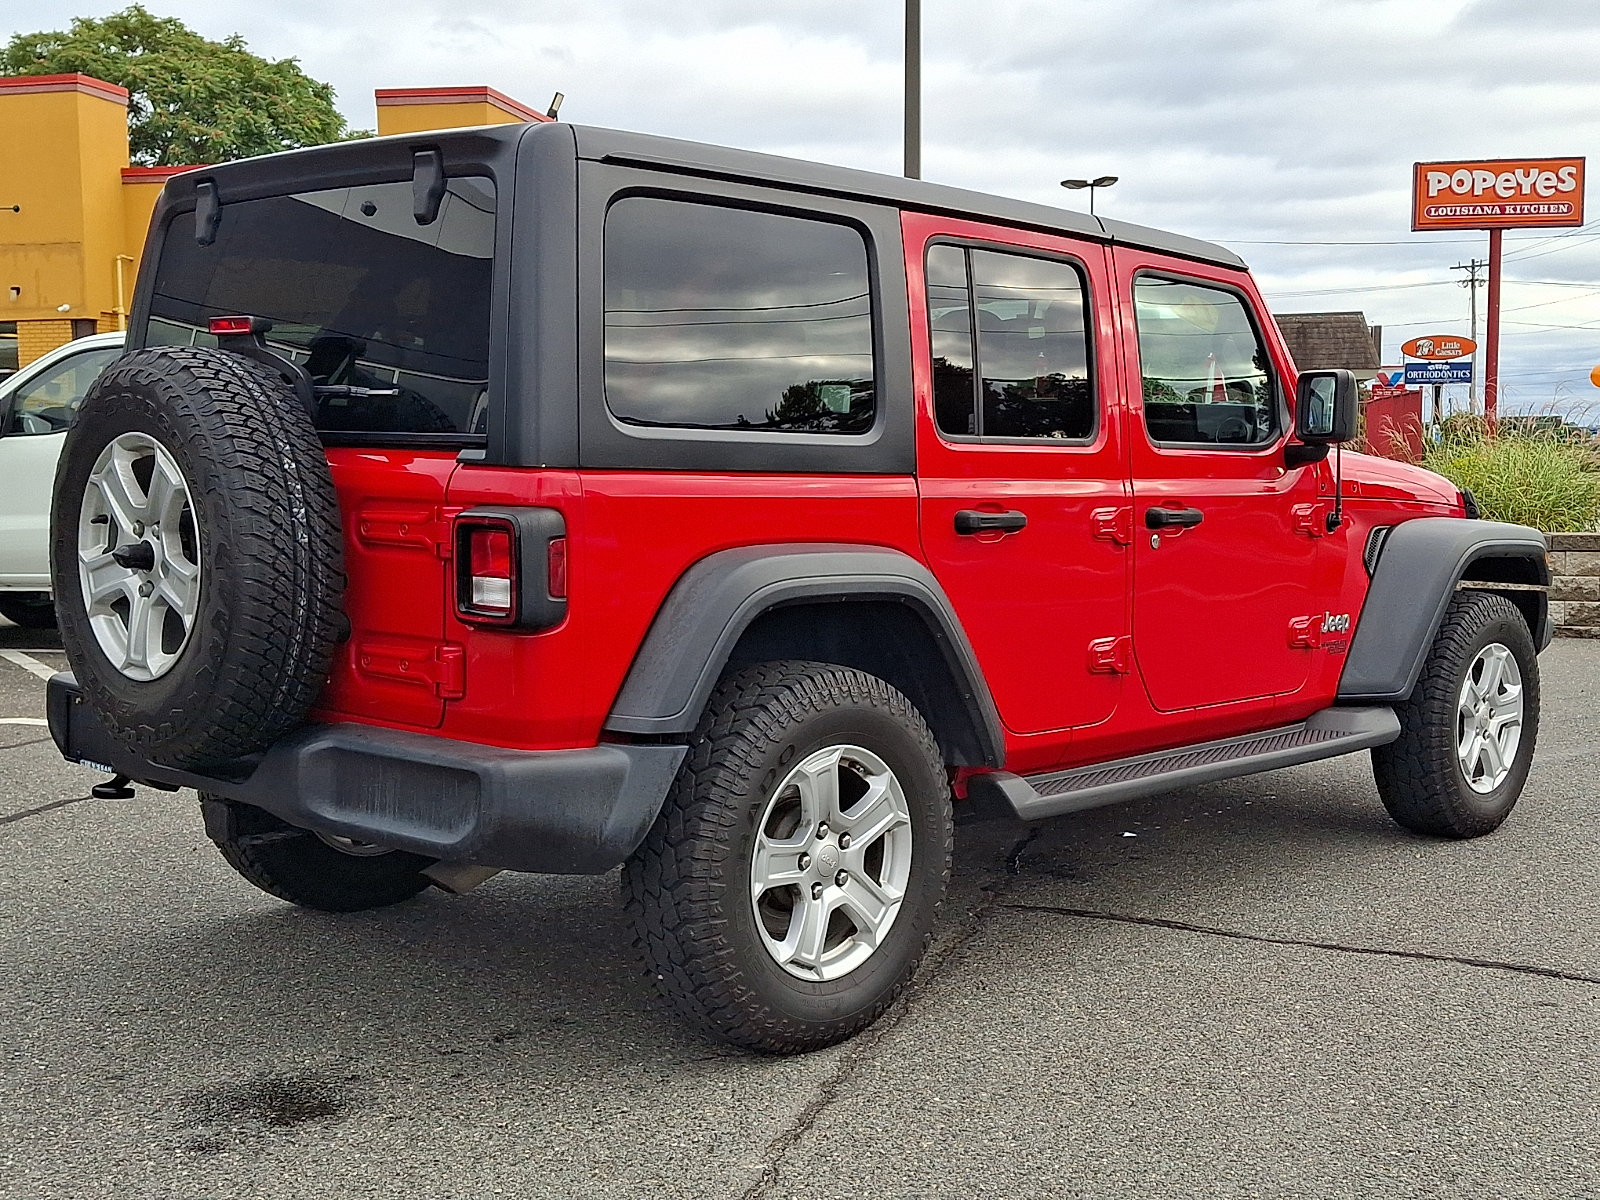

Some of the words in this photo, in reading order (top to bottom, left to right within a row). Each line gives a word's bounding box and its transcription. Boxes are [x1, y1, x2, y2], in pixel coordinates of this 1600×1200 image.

[1430, 206, 1501, 216] LOUISIANA
[1505, 204, 1569, 214] KITCHEN
[1441, 341, 1460, 350] Little
[1407, 370, 1471, 379] ORTHODONTICS
[1321, 611, 1350, 634] Jeep
